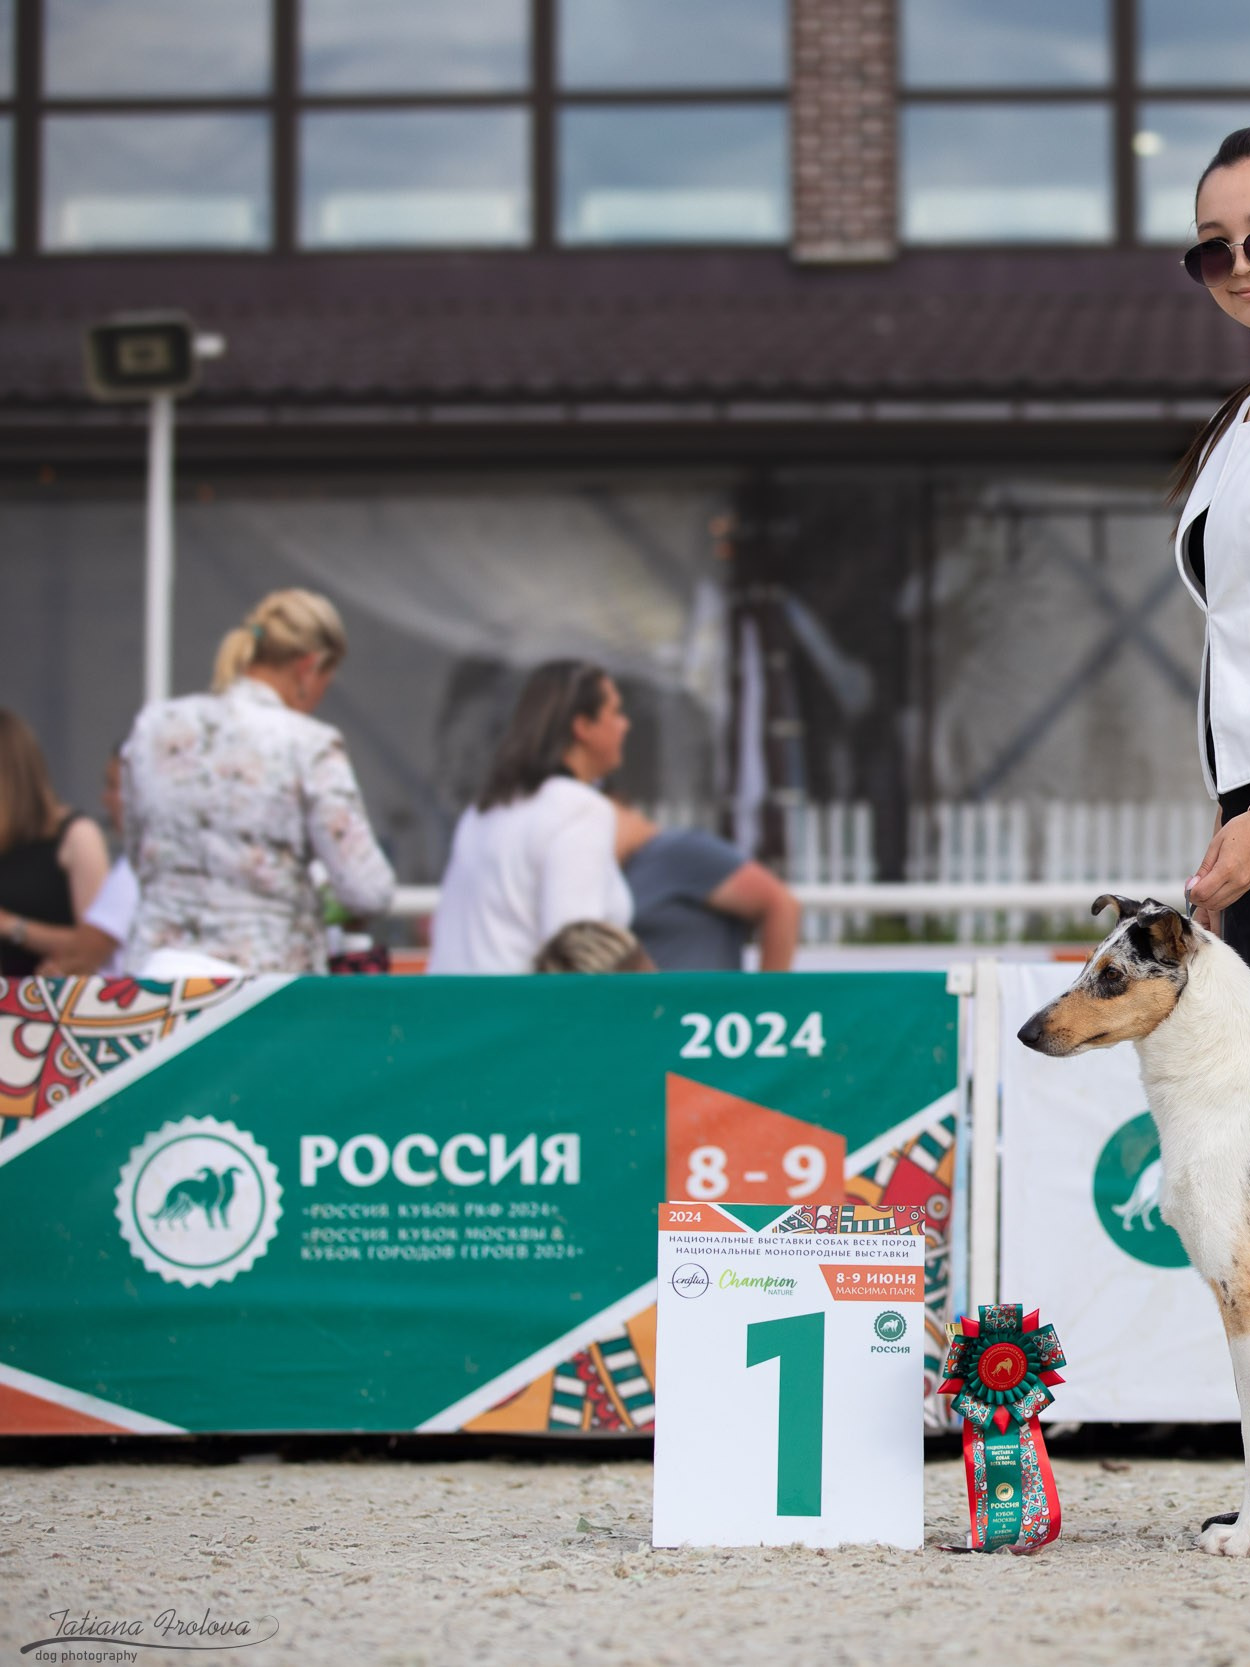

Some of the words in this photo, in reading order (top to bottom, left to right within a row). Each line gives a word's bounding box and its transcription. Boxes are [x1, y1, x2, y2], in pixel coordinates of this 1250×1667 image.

[680, 1011, 826, 1058] 2024
[300, 1133, 581, 1187] РОССИЯ
[398, 1202, 459, 1218] КУБОК
[668, 1210, 702, 1223] 2024
[398, 1226, 459, 1242] КУБОК
[464, 1226, 547, 1242] МОСКВЫ
[669, 1235, 754, 1245] НАЦИОНАЛЬНЫЕ
[758, 1237, 812, 1246] ВЫСТАВКИ
[816, 1238, 849, 1246] СОБАК
[853, 1239, 878, 1247] ВСЕХ
[882, 1239, 917, 1248] ПОРОД
[676, 1247, 761, 1256] НАЦИОНАЛЬНЫЕ
[765, 1248, 851, 1258] МОНОПОРОДНЫЕ
[855, 1250, 909, 1258] ВЫСТАВКИ
[718, 1268, 798, 1292] Champion
[836, 1272, 861, 1284] 8-9
[866, 1273, 917, 1285] ИЮНЯ
[767, 1288, 793, 1296] NATURE
[835, 1286, 887, 1296] МАКСИМА
[889, 1287, 915, 1296] ПАРК
[870, 1345, 911, 1354] РОССИЯ
[746, 1311, 826, 1517] 1
[990, 1502, 1020, 1510] РОССИЯ
